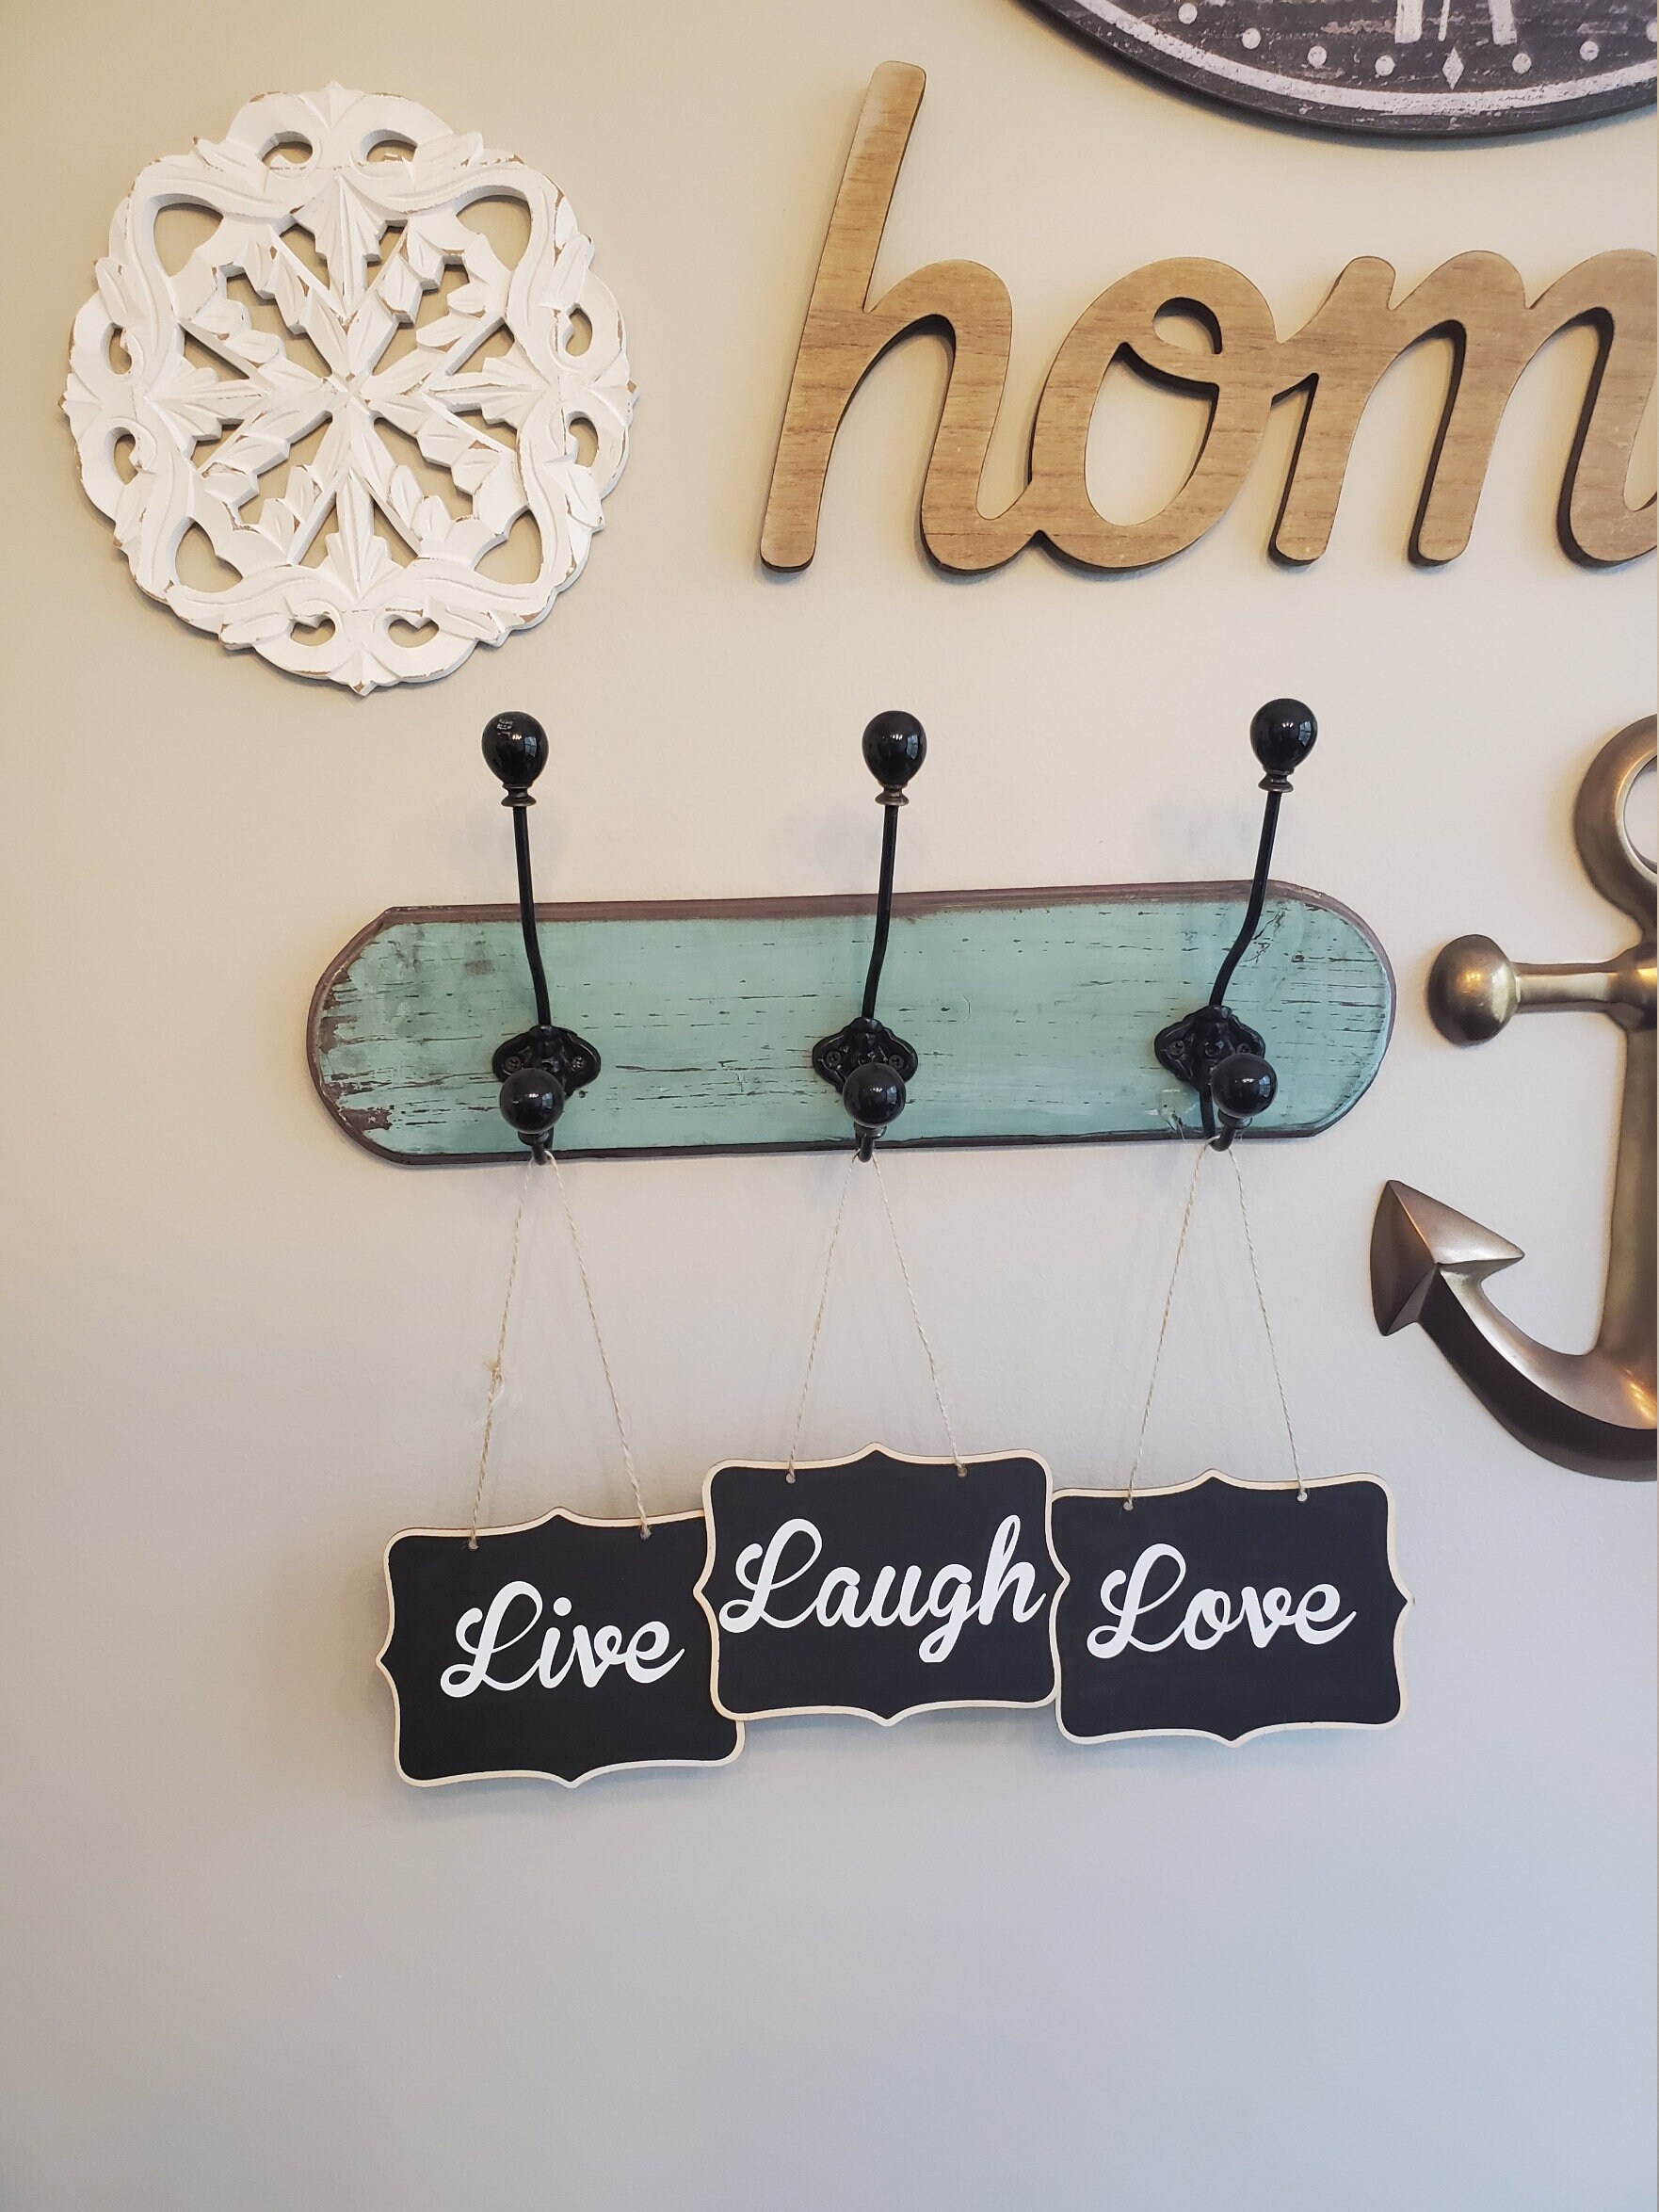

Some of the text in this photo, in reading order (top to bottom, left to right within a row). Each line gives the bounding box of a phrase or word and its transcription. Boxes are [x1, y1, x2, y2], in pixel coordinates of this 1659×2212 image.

[440, 1580, 685, 1698] Live
[718, 1514, 1046, 1663] Laugh
[1087, 1542, 1357, 1659] Love
